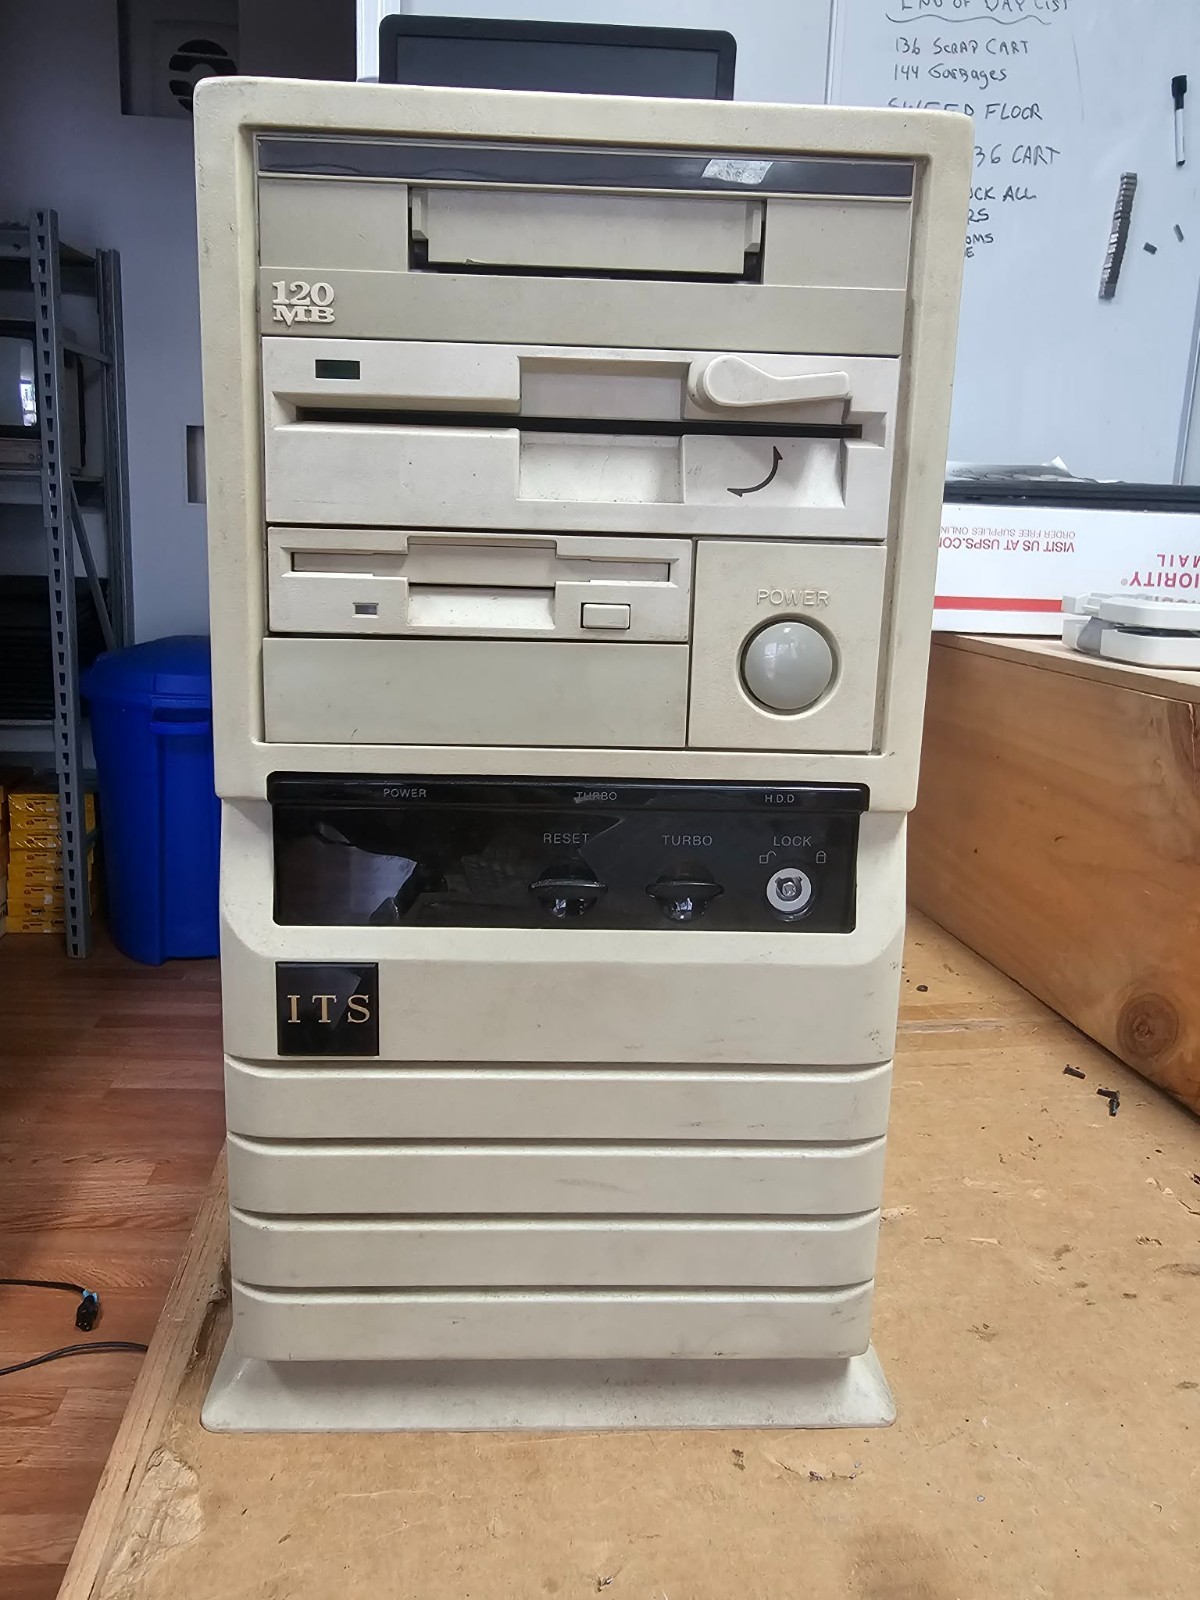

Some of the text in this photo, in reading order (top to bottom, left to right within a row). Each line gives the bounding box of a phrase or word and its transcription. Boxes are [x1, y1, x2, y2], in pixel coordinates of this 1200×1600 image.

[896, 37, 921, 55] 136
[985, 38, 1029, 55] CART
[894, 64, 919, 81] 144
[985, 103, 1043, 120] FLOOR
[1012, 145, 1061, 166] CART
[1003, 185, 1037, 202] ALL
[272, 280, 335, 307] 120
[272, 305, 336, 327] MB
[972, 526, 1016, 537] SUPPLIES
[1018, 529, 1041, 538] FREE
[1044, 530, 1076, 539] ORDER
[1003, 539, 1020, 551] AT
[1022, 540, 1040, 552] US
[1043, 541, 1075, 553] VISIT
[756, 588, 830, 607] POWER
[383, 788, 428, 799] POWER
[543, 833, 590, 844] RESET
[662, 834, 713, 847] TURBO
[773, 836, 813, 847] LOCK
[286, 994, 371, 1024] ITS
